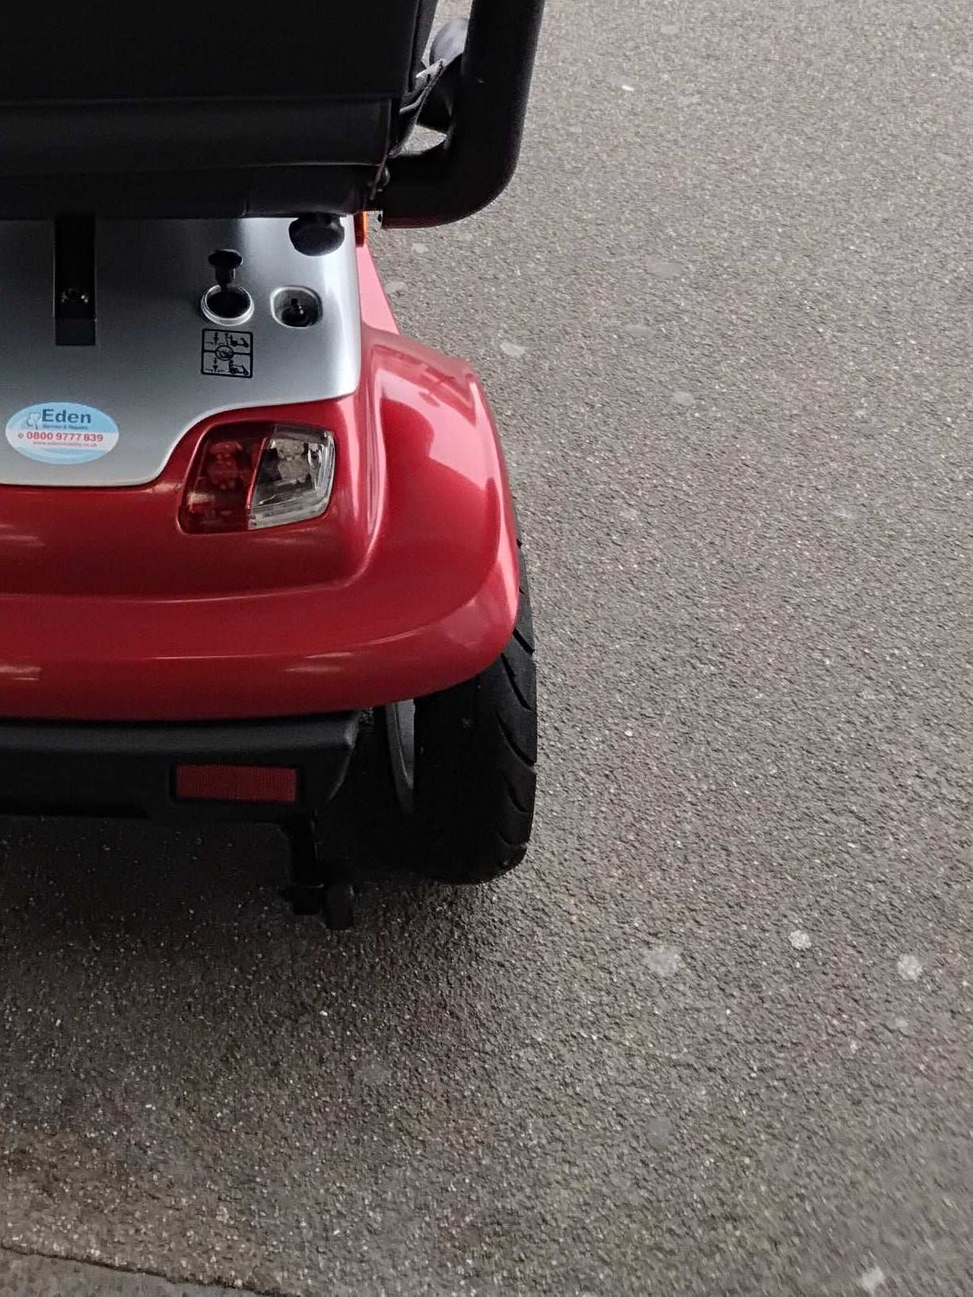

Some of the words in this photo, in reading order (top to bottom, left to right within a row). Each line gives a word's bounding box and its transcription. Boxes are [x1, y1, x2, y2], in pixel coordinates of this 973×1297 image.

[41, 408, 91, 424] Eden
[27, 431, 53, 440] 0800
[56, 432, 81, 441] 9777
[83, 433, 104, 442] 839
